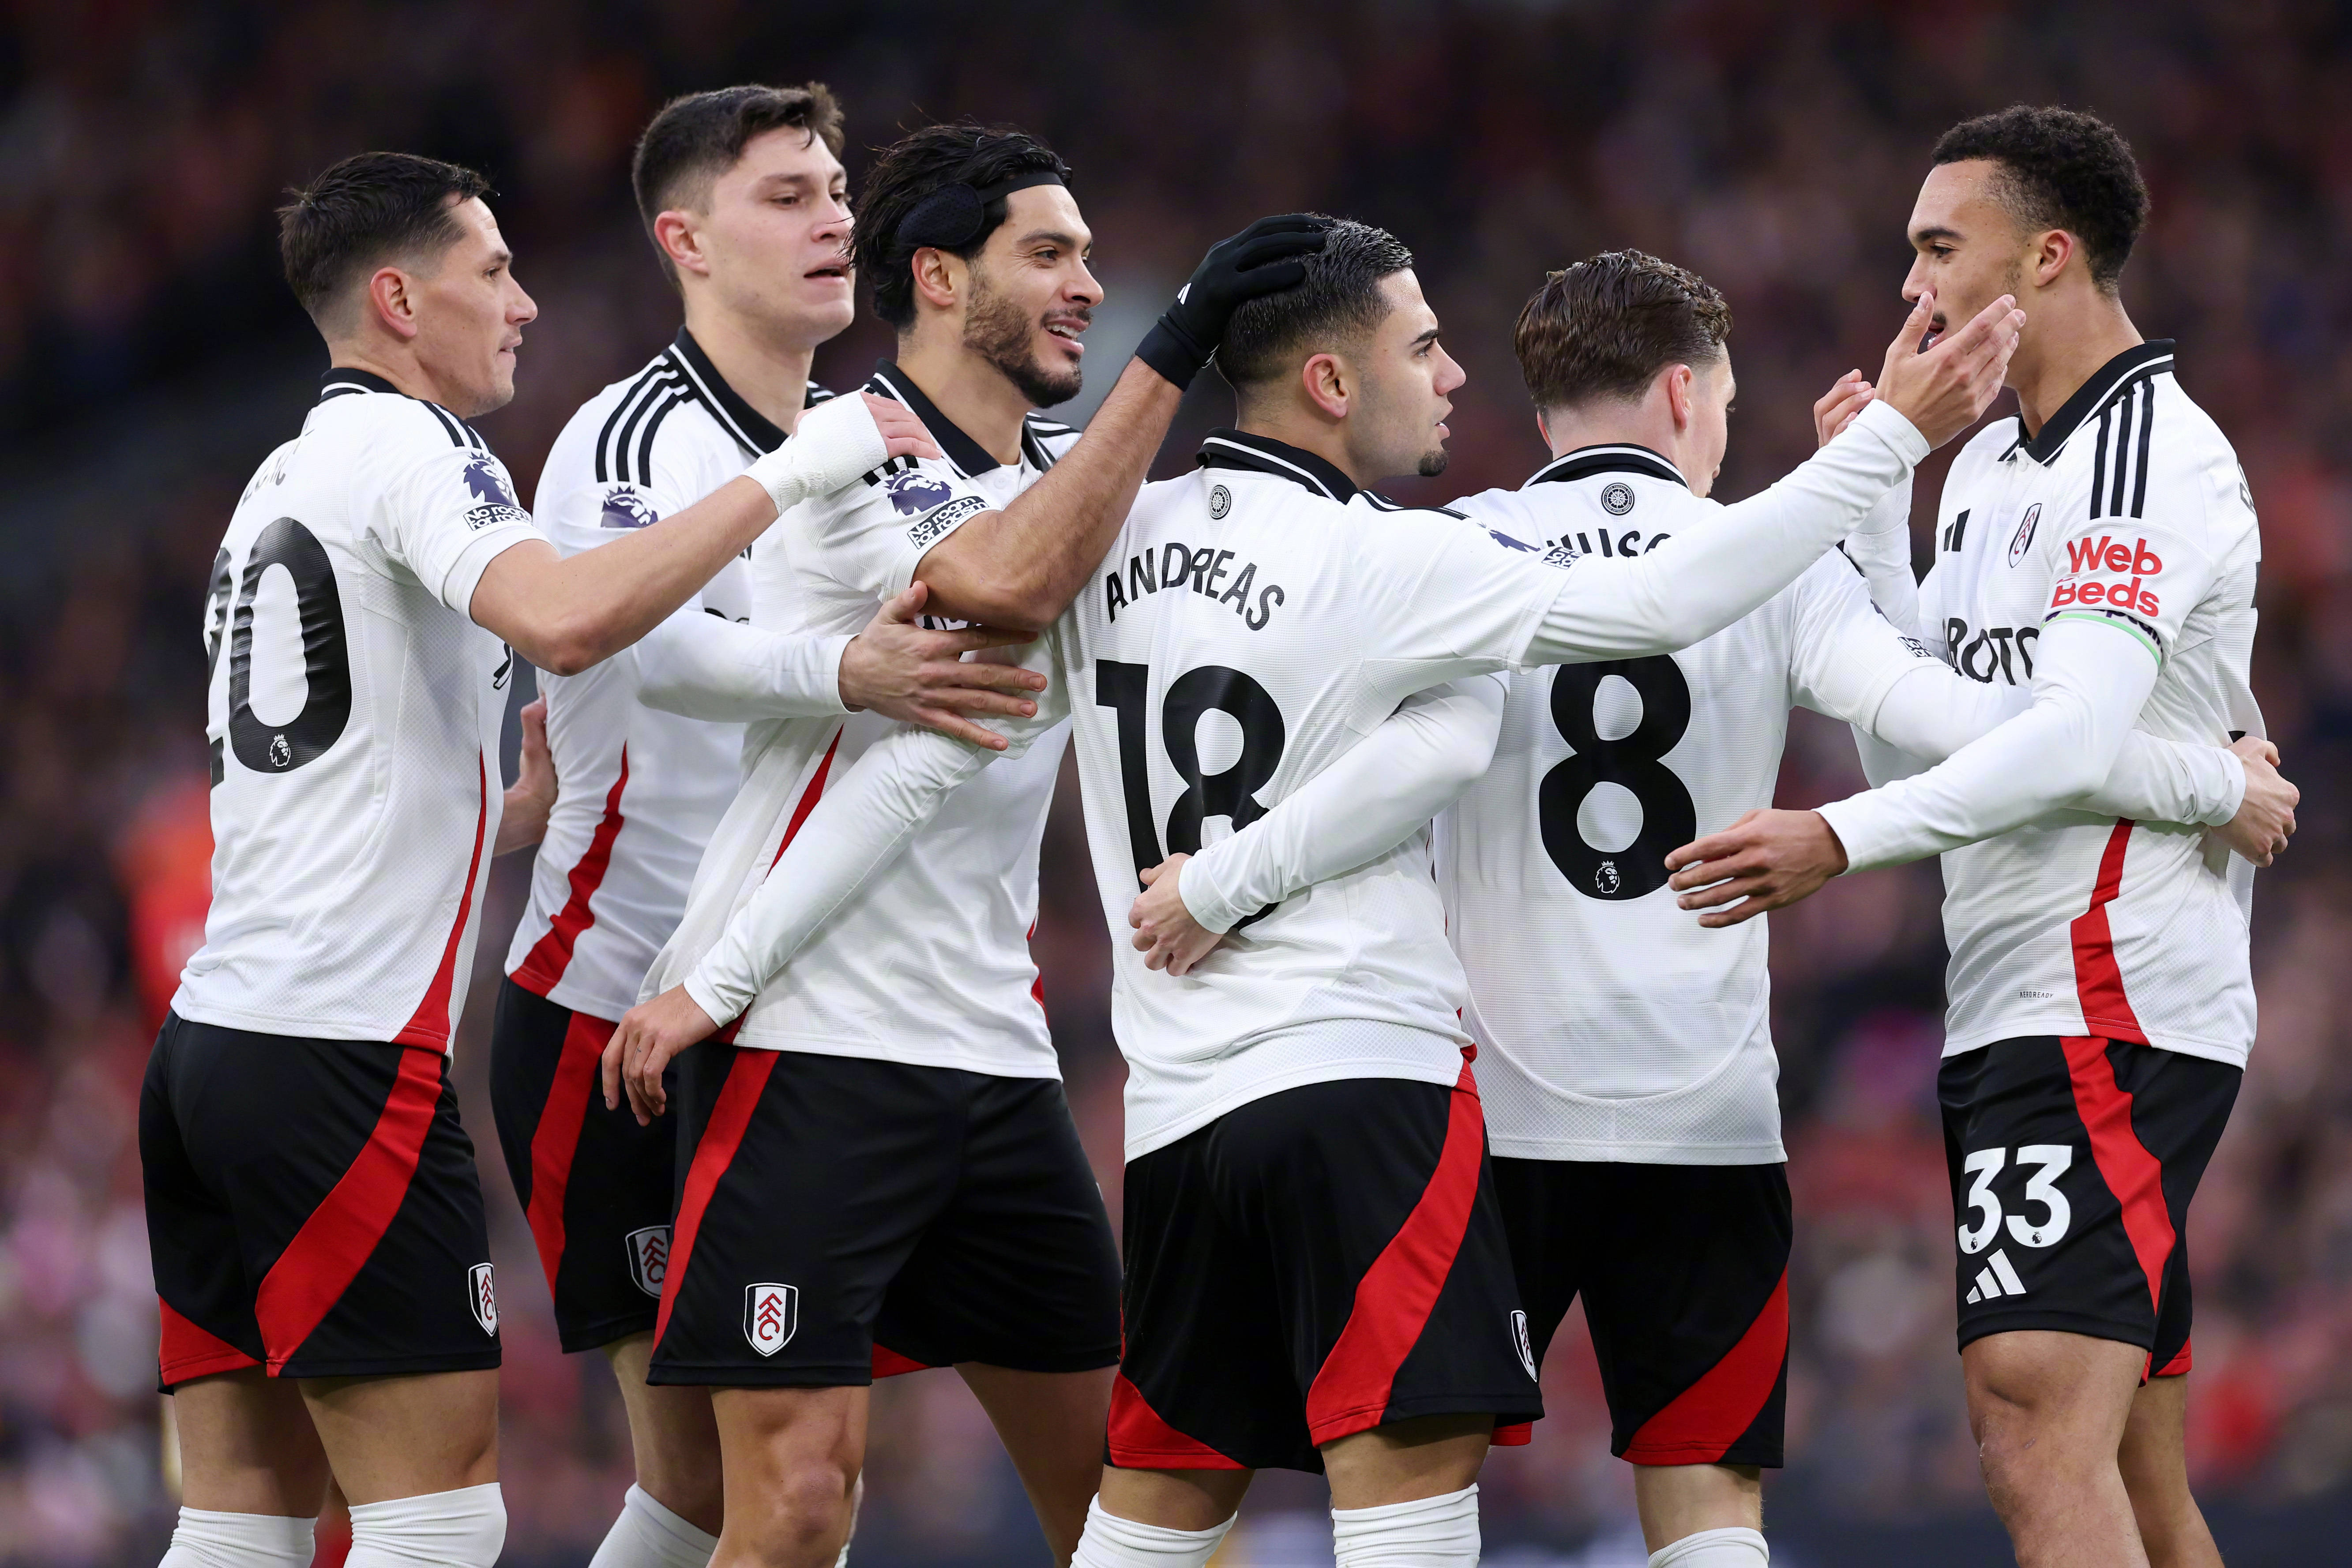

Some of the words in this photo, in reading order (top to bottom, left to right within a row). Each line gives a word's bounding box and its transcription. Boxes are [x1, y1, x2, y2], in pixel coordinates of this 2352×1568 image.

[464, 509, 490, 524] No
[908, 522, 932, 541] No
[932, 498, 976, 524] room
[913, 527, 935, 549] for
[936, 502, 989, 532] racism
[2067, 536, 2162, 575] Web
[1107, 542, 1285, 631] ANDREAS
[2051, 576, 2160, 617] Beds
[1096, 659, 1285, 930] 18
[1539, 654, 1696, 901] 8
[1958, 1144, 2073, 1255] 33
[757, 1293, 783, 1341] FFC
